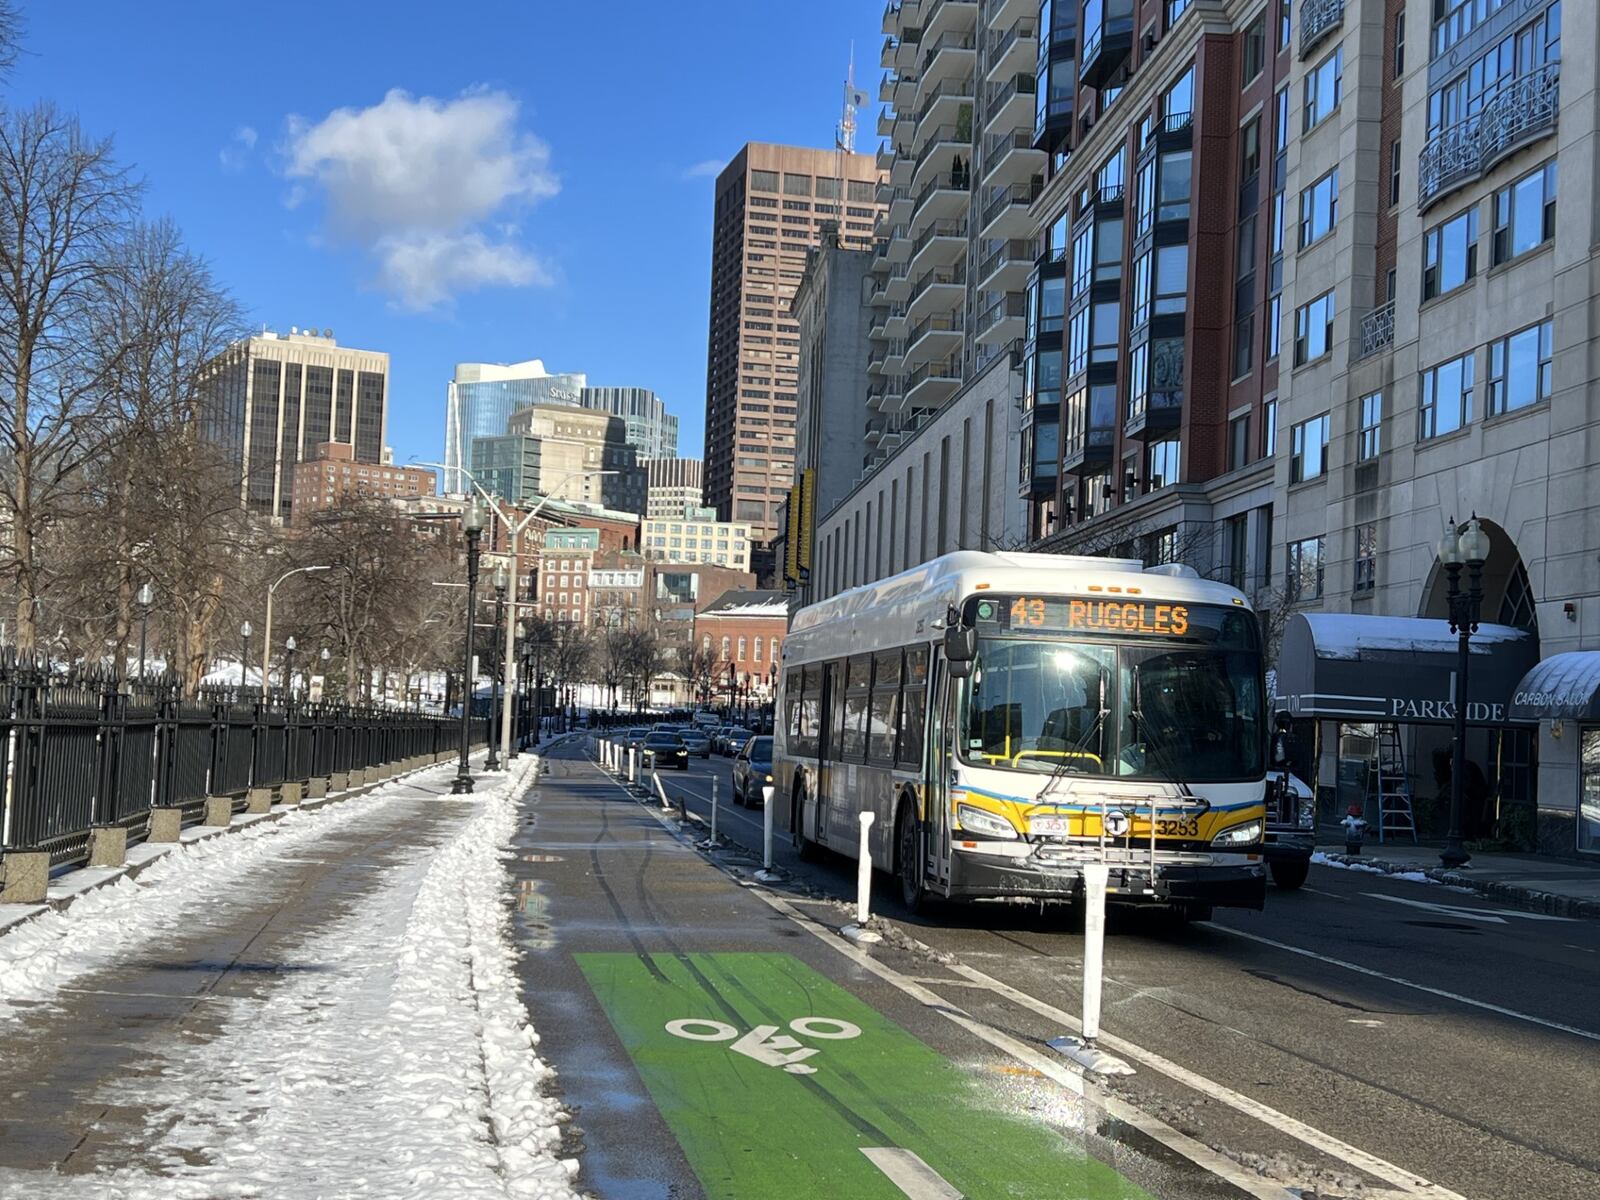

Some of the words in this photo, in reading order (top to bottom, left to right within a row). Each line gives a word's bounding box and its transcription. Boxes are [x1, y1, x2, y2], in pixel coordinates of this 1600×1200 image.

[1011, 597, 1045, 625] 43
[1069, 600, 1188, 635] RUGGLES
[1514, 691, 1554, 706] CARBON
[1556, 692, 1589, 706] SALON
[1157, 820, 1199, 837] 3253
